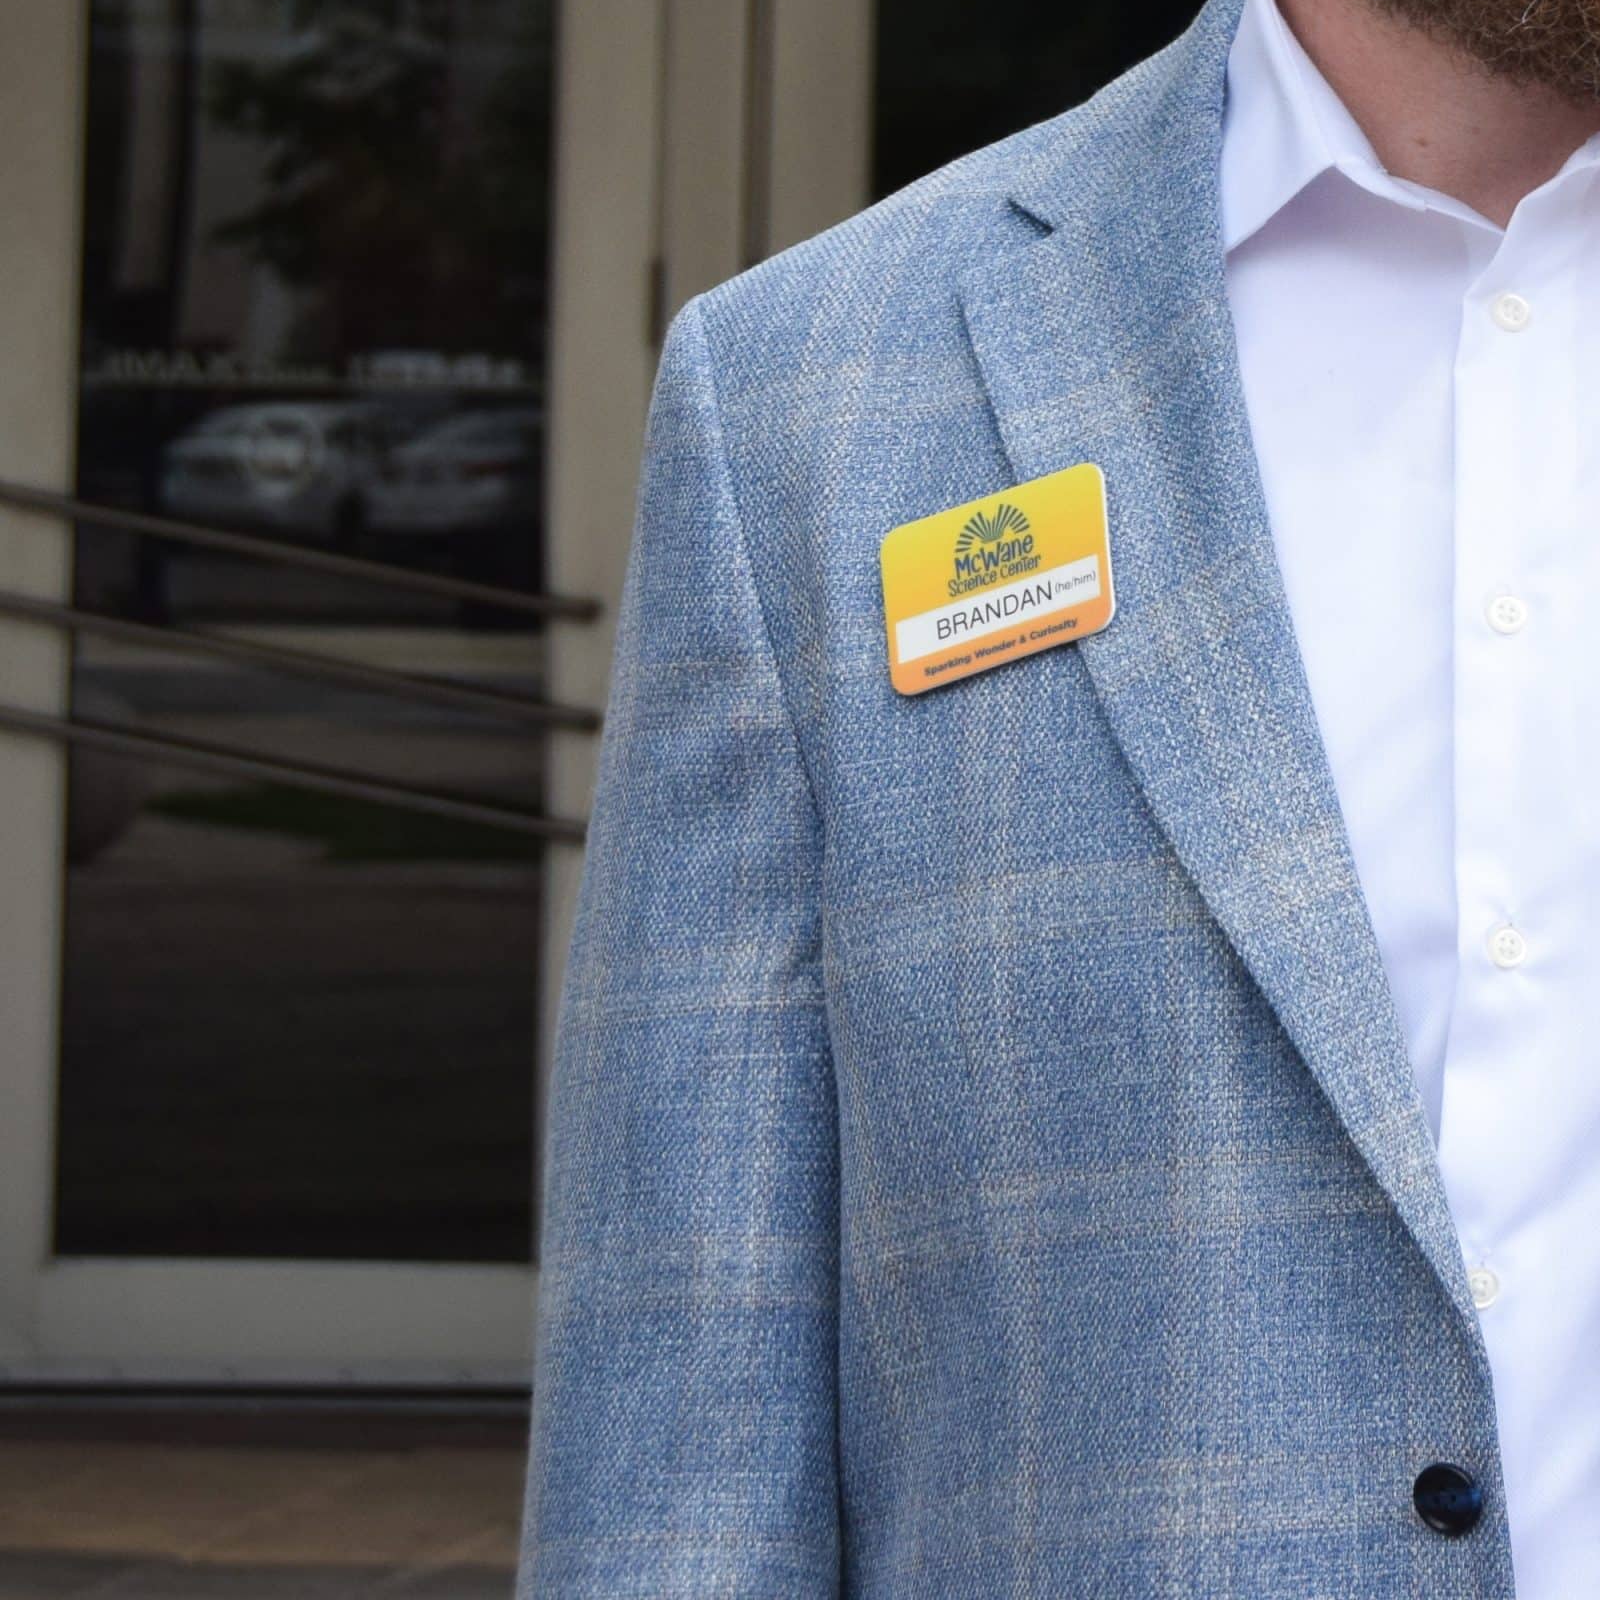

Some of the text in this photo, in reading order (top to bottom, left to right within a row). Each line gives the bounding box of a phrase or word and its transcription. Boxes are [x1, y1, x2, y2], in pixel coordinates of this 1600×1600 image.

[954, 534, 1034, 580] McWane
[936, 580, 1053, 641] BRANDAN
[947, 570, 998, 598] Science
[924, 617, 1078, 677] Sparking Wonder & Curiosity
